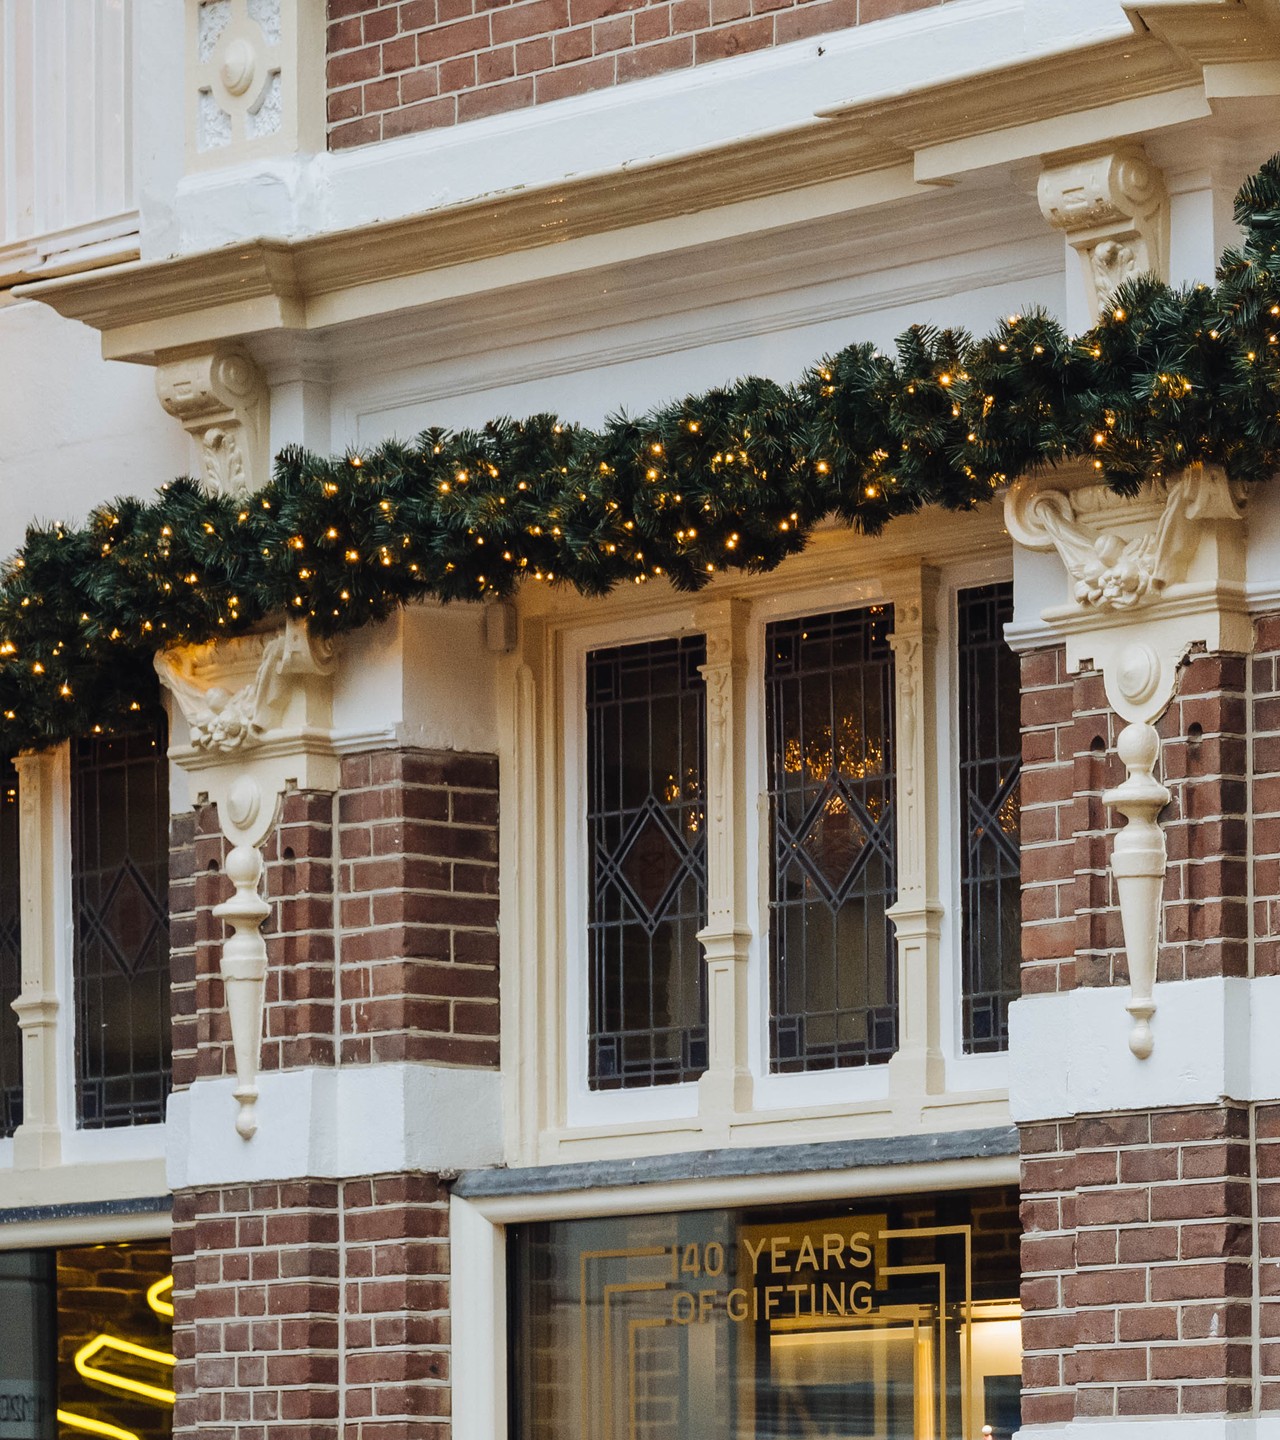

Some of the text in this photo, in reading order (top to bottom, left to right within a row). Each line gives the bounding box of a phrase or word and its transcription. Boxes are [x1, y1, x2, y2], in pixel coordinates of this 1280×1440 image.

[671, 1231, 872, 1281] 140 YEARS
[672, 1280, 873, 1325] OF GIFTING
